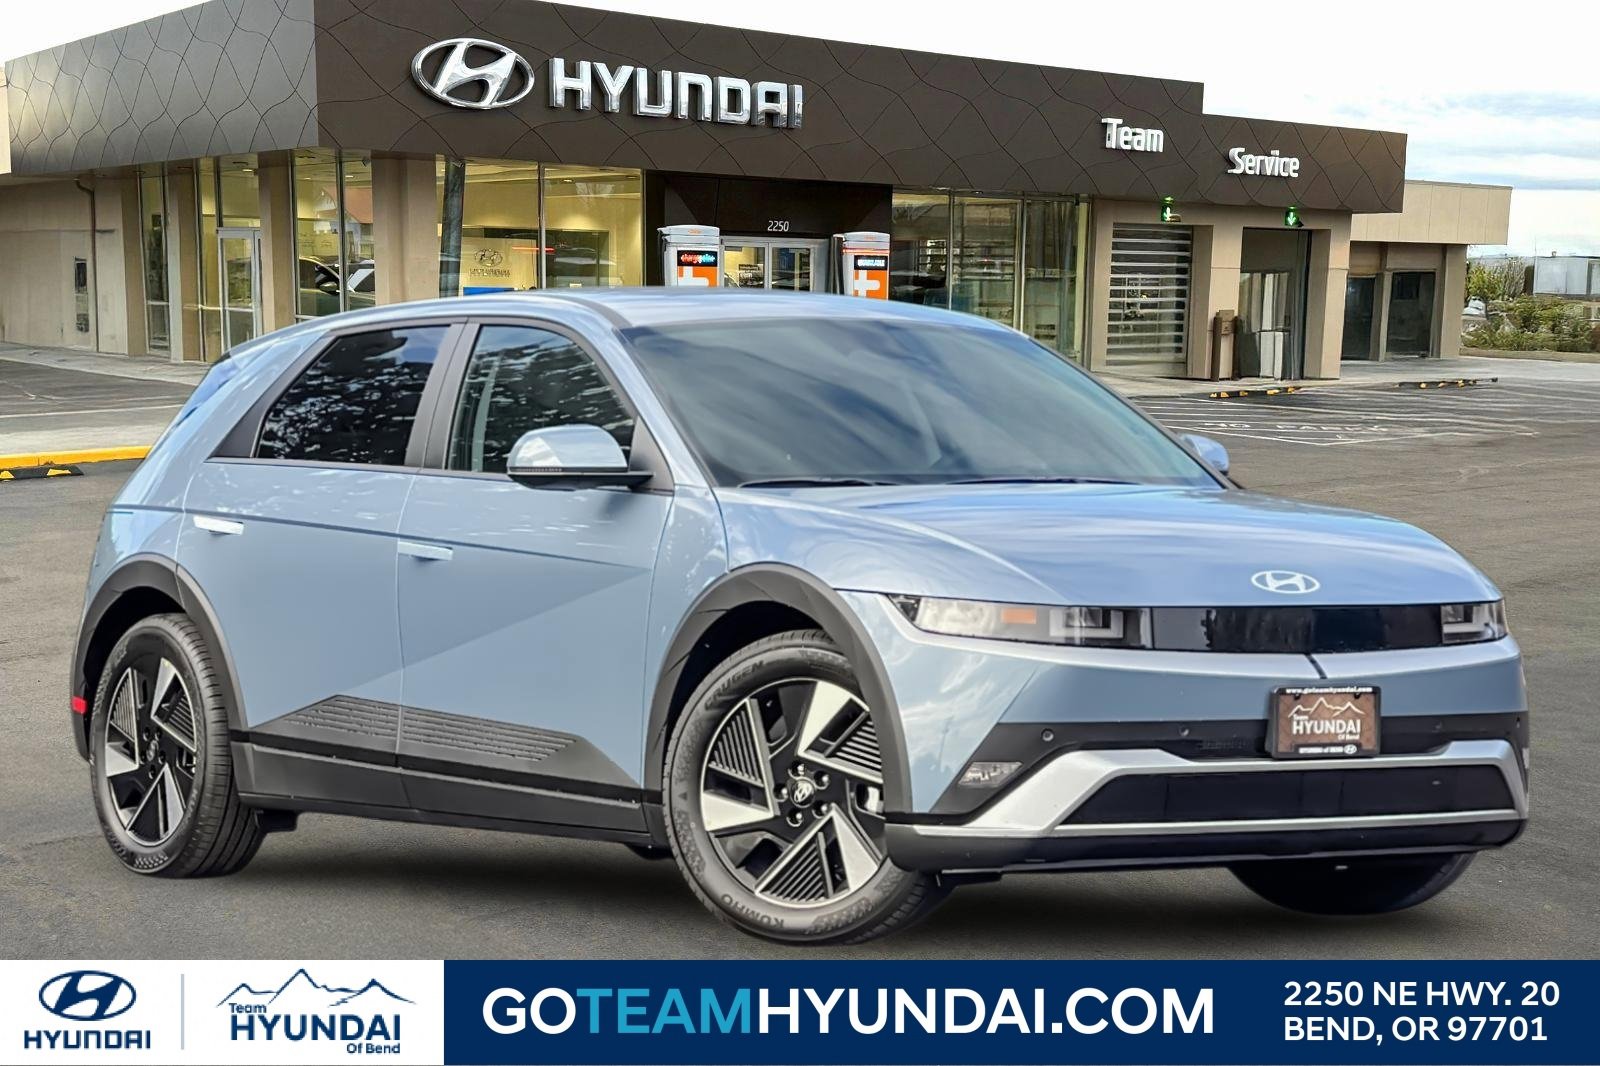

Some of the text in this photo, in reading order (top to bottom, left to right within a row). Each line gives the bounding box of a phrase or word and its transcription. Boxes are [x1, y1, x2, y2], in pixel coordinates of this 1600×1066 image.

[549, 57, 803, 129] HYUNDAI
[1101, 117, 1164, 153] Team
[1227, 147, 1300, 178] Service
[767, 220, 790, 232] 2250
[1292, 719, 1361, 735] HYUNDAI
[721, 894, 784, 929] KUMHO
